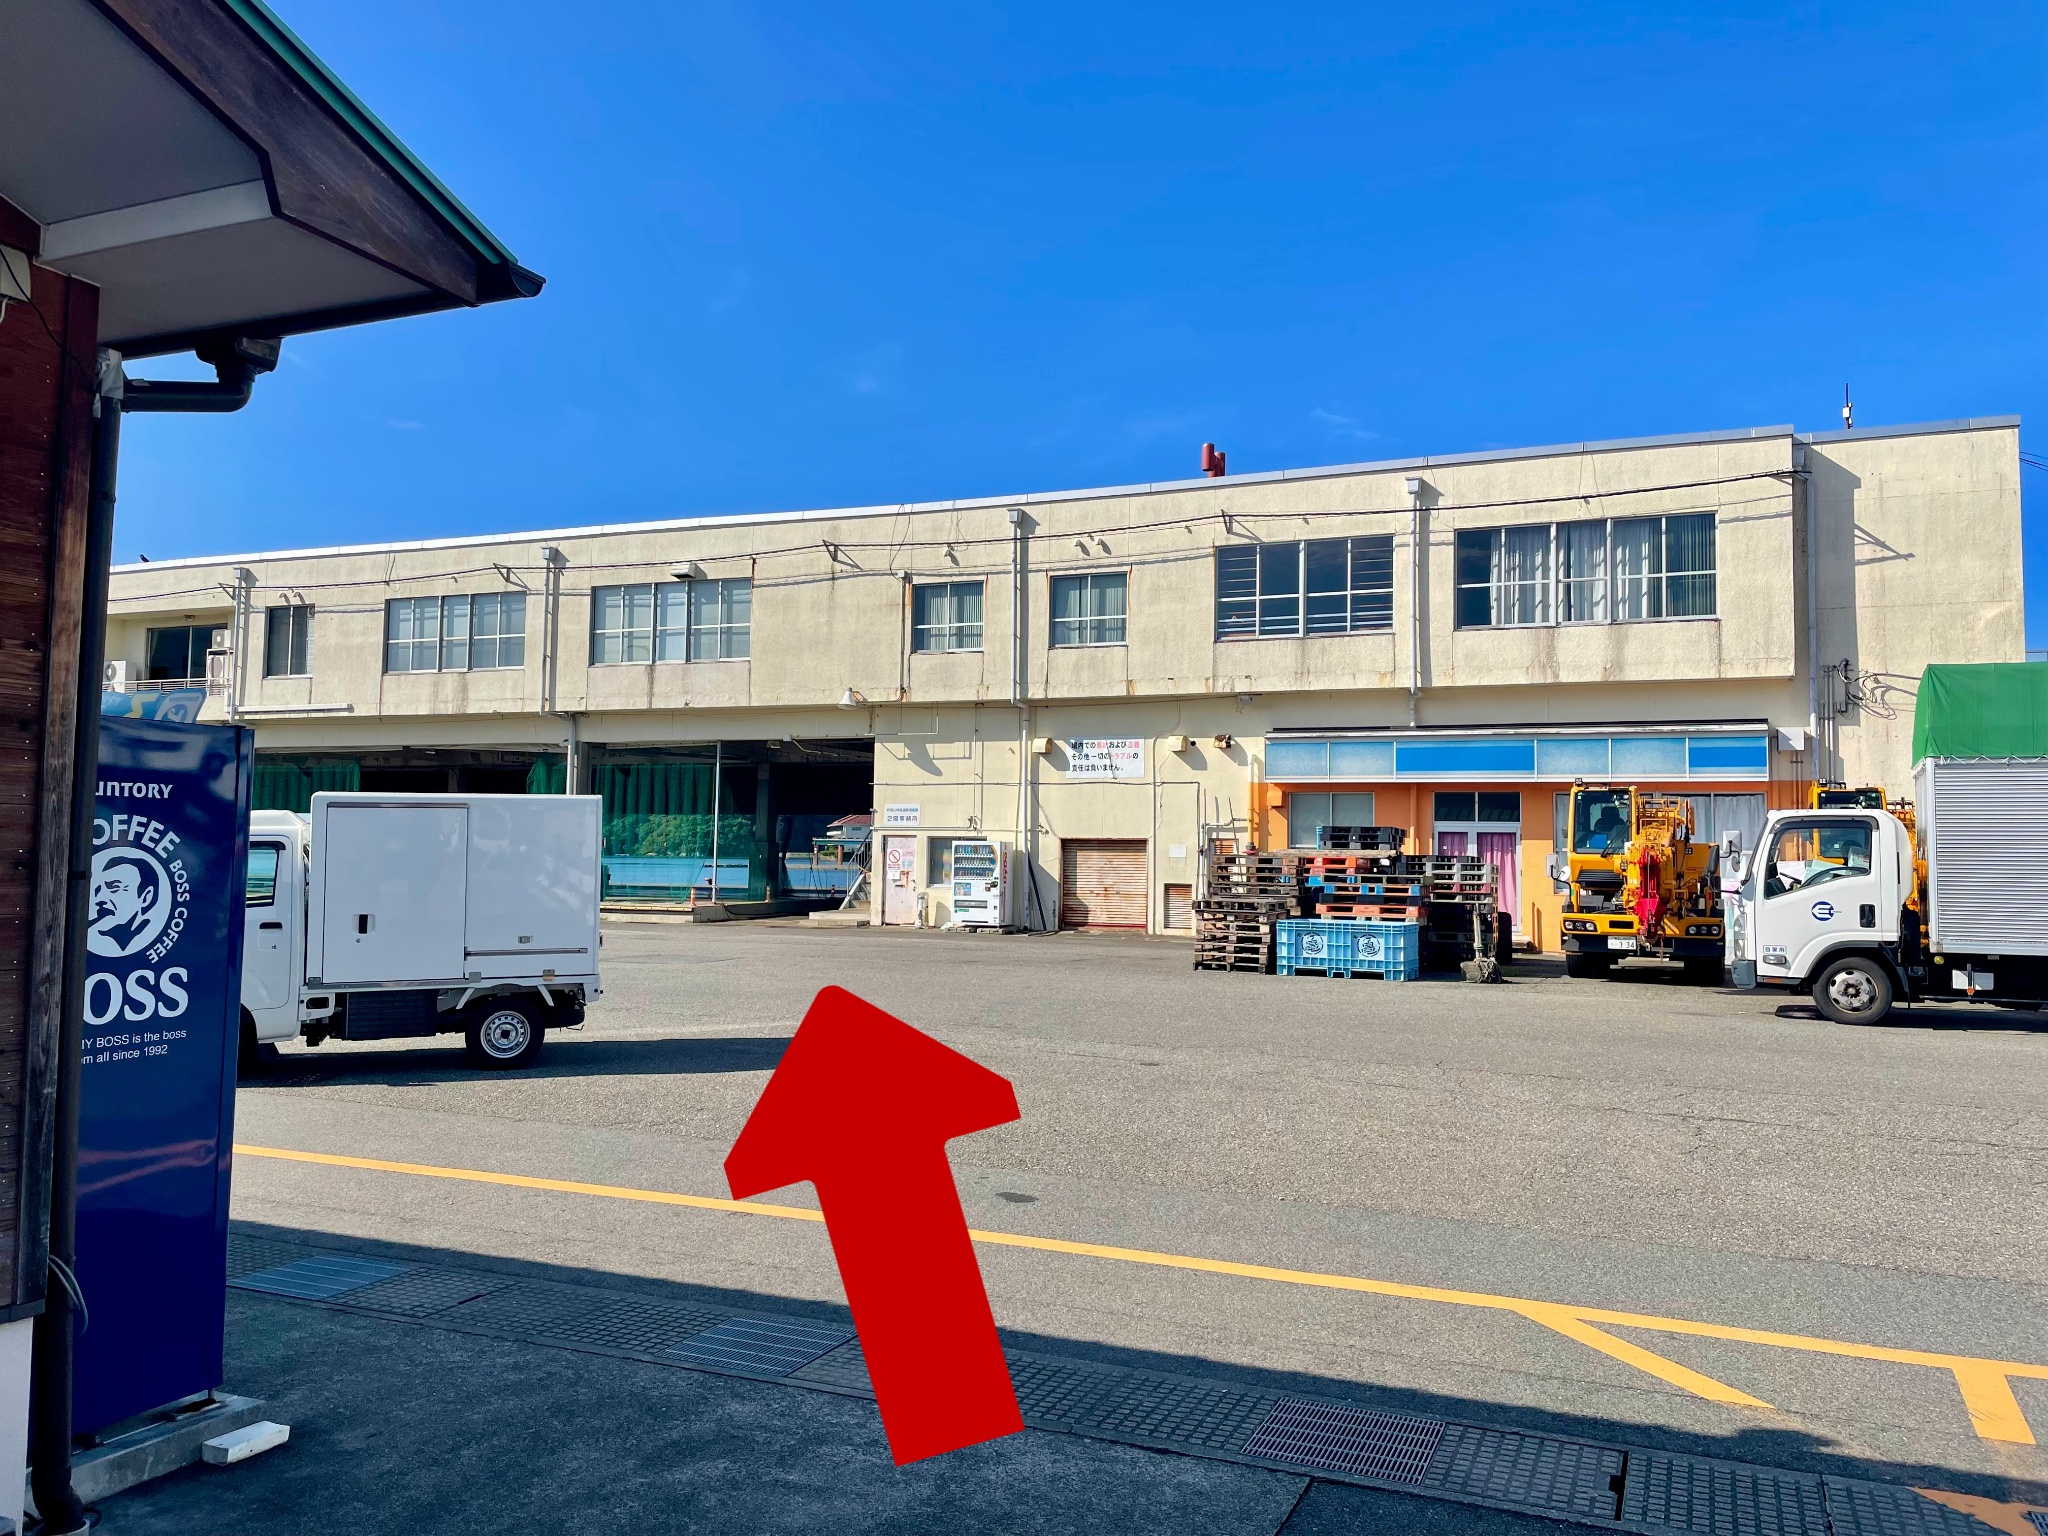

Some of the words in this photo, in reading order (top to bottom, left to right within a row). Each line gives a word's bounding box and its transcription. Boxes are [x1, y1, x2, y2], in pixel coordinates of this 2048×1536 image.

[95, 781, 173, 799] UNTORY
[92, 814, 180, 859] OFFEE
[169, 859, 190, 902] BOSS
[145, 907, 188, 964] COFFEE
[83, 967, 189, 1025] OSS
[96, 1034, 130, 1048] BOSS
[132, 1033, 141, 1044] is
[144, 1032, 160, 1042] the
[162, 1030, 187, 1040] boss
[96, 1050, 110, 1063] all
[112, 1049, 140, 1061] since
[143, 1044, 168, 1057] 1992
